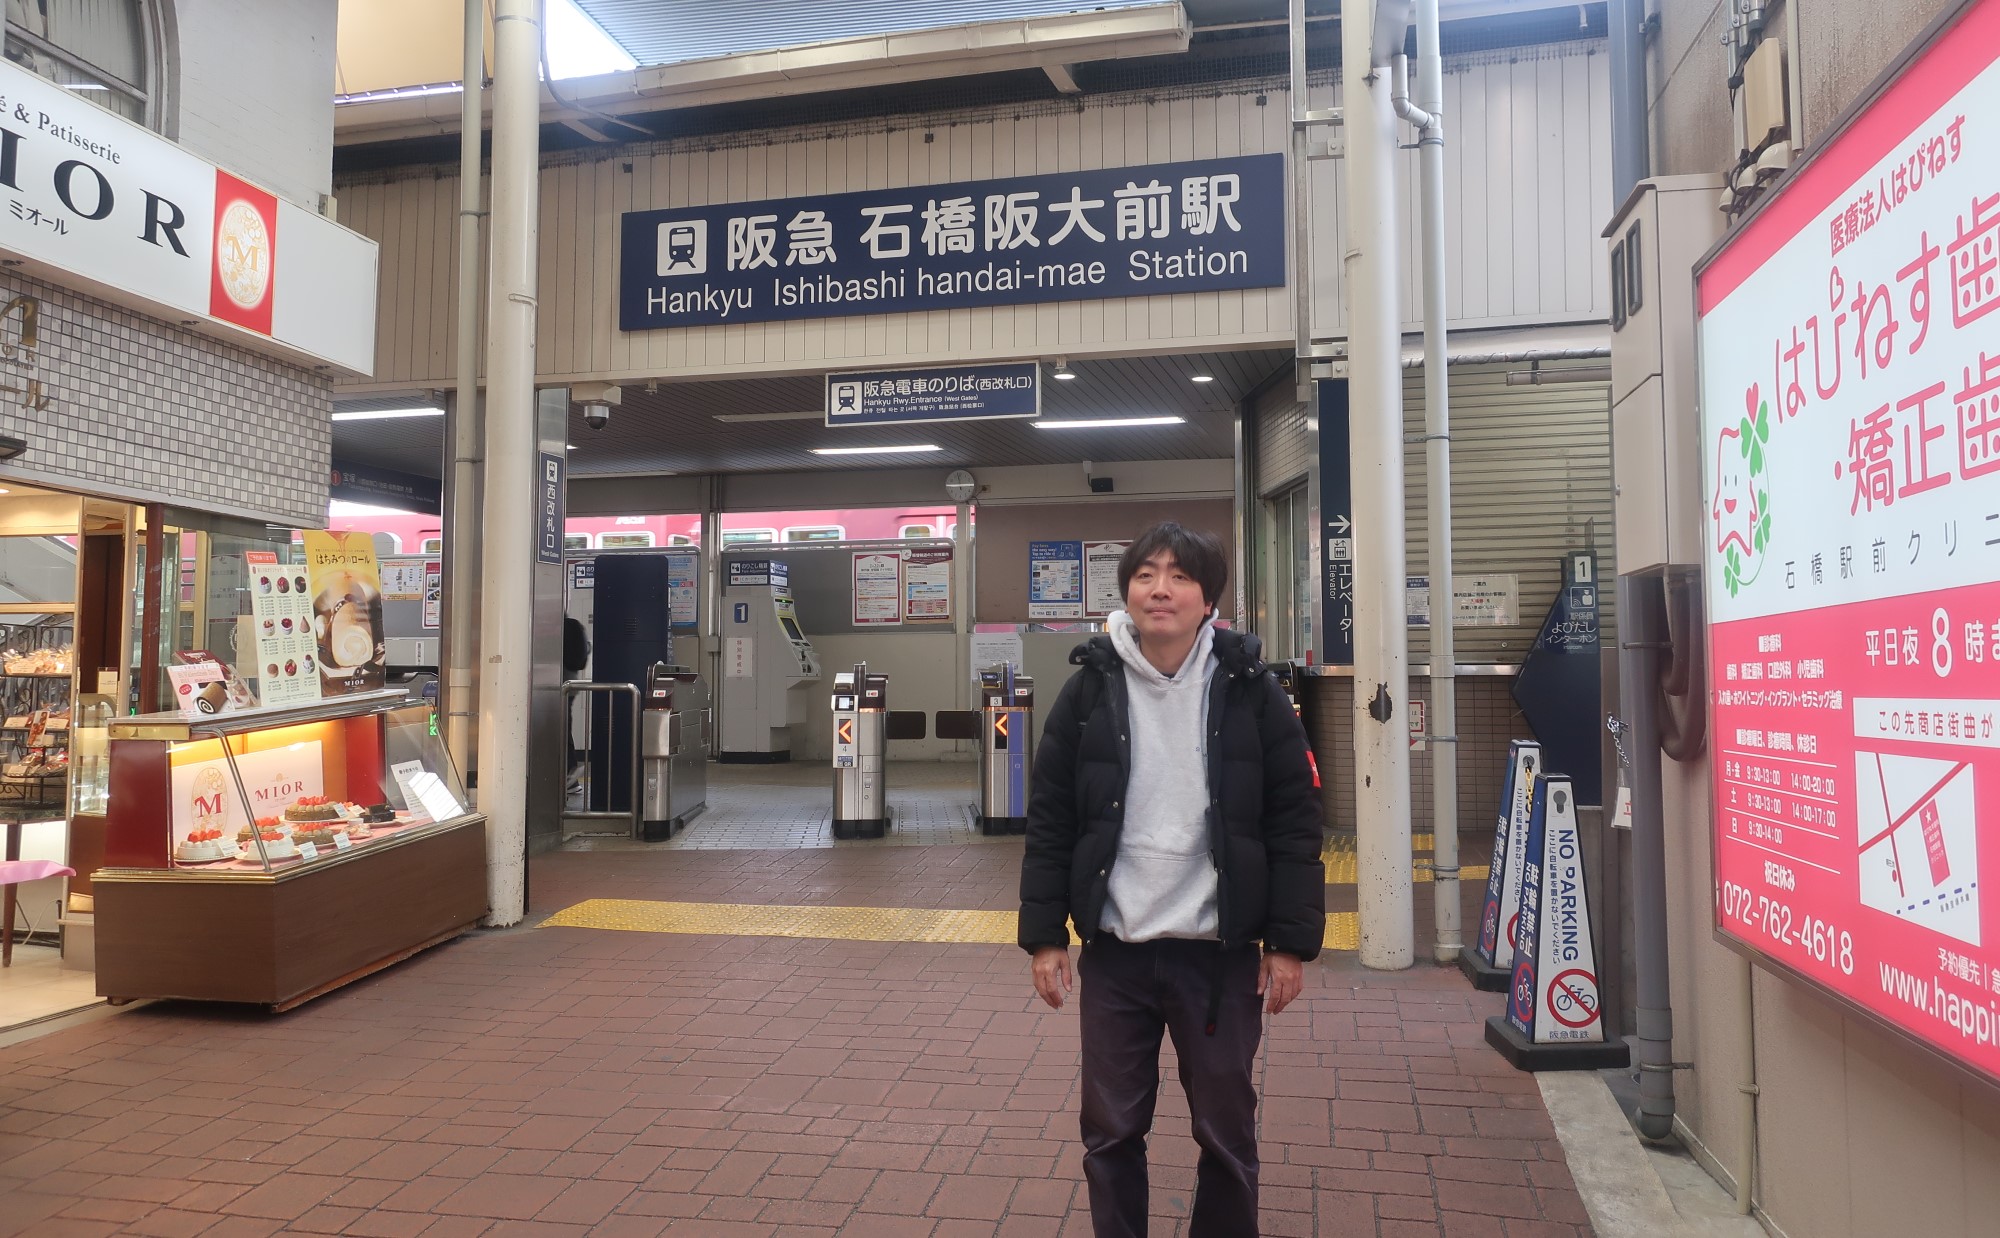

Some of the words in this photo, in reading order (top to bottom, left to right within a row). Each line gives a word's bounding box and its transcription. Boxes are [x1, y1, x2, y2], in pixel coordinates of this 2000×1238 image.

[14, 103, 30, 124] &
[37, 111, 121, 165] Patisserie
[1830, 114, 1966, 259] 医療法人はぴねす
[9, 199, 69, 236] ミオール
[726, 209, 837, 272] 阪急
[859, 173, 1241, 259] 石橋阪大前駅
[646, 282, 753, 318] Hankyu
[773, 265, 905, 307] Ishibashi
[917, 257, 1105, 298] handai-mae
[1128, 247, 1248, 282] Station
[864, 374, 1033, 397] 阪急電車のりば(西改札口)
[864, 398, 891, 406] Hankyu
[893, 395, 942, 405] Rwy.Entrance
[547, 483, 556, 548] 西改札口
[1329, 564, 1337, 600] Elevator
[1579, 561, 1586, 577] 1
[737, 605, 746, 621] 1
[1339, 564, 1353, 644] エレベーター
[1570, 611, 1594, 621] 駅係員
[1546, 634, 1597, 644] インターホン
[1551, 621, 1596, 634] よびだし
[344, 679, 364, 687] MIOR
[1767, 661, 1792, 679] 口腔外科
[1797, 659, 1824, 679] 小児歯科
[1879, 710, 1993, 739] この先商店街曲が
[255, 781, 303, 801] MIOR
[1746, 765, 1781, 786] 9:30-13:00
[1791, 773, 1835, 796] 14:00-20:00
[195, 792, 223, 818] M
[1731, 787, 1737, 803] 土
[1747, 793, 1782, 814] 9:30-13:00
[1792, 802, 1836, 828] 14:00-17:00
[1498, 814, 1503, 833] NO
[1732, 817, 1738, 833] 日
[1748, 821, 1783, 844] 9:30-14:00
[1558, 830, 1574, 860] NO
[1490, 835, 1500, 891] PARKING
[1525, 862, 1531, 883] NO
[1764, 860, 1795, 892] 祝日休み
[1524, 863, 1540, 958] 駐輪禁止
[1549, 829, 1560, 964] ここに自転車を置かないでください
[1519, 886, 1529, 950] PARKING
[1560, 866, 1579, 961] PARKING
[1724, 880, 1854, 975] 072-762-4618
[1938, 947, 1980, 985] 予約優先
[1879, 961, 2000, 1048] www.happi
[1549, 1030, 1590, 1040] 阪急電鉄
